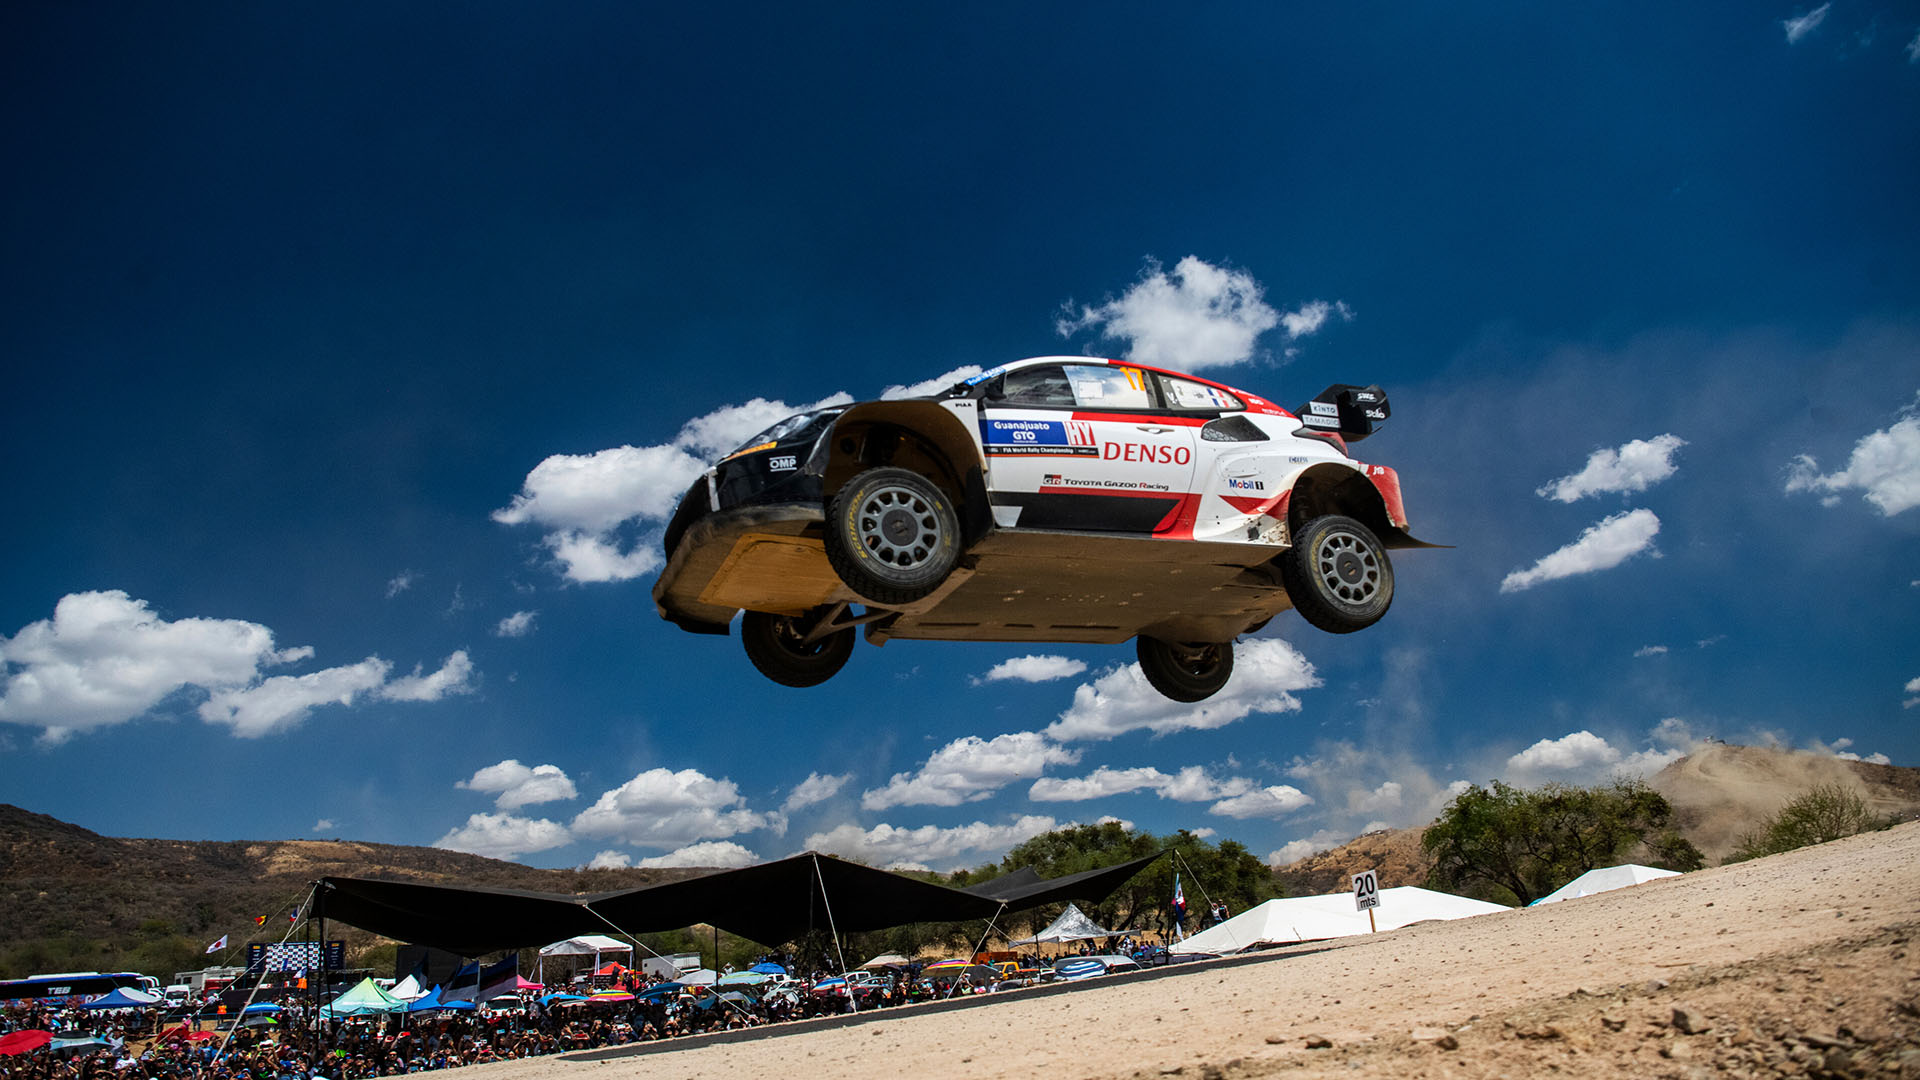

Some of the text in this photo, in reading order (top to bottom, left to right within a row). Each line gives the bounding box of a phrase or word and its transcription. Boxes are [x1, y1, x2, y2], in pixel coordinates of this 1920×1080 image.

[1119, 367, 1146, 391] 17
[993, 421, 1050, 431] Guanajuato
[1012, 431, 1036, 440] GTO
[1067, 421, 1095, 446] HY
[1027, 447, 1040, 455] Rally
[1103, 441, 1190, 465] DENSO
[769, 459, 797, 469] OMP
[1043, 476, 1169, 491] GR TOYOTA GAZOO Racing
[1229, 479, 1264, 490] Mobil 1
[1355, 873, 1375, 897] 20
[1360, 897, 1376, 909] mts
